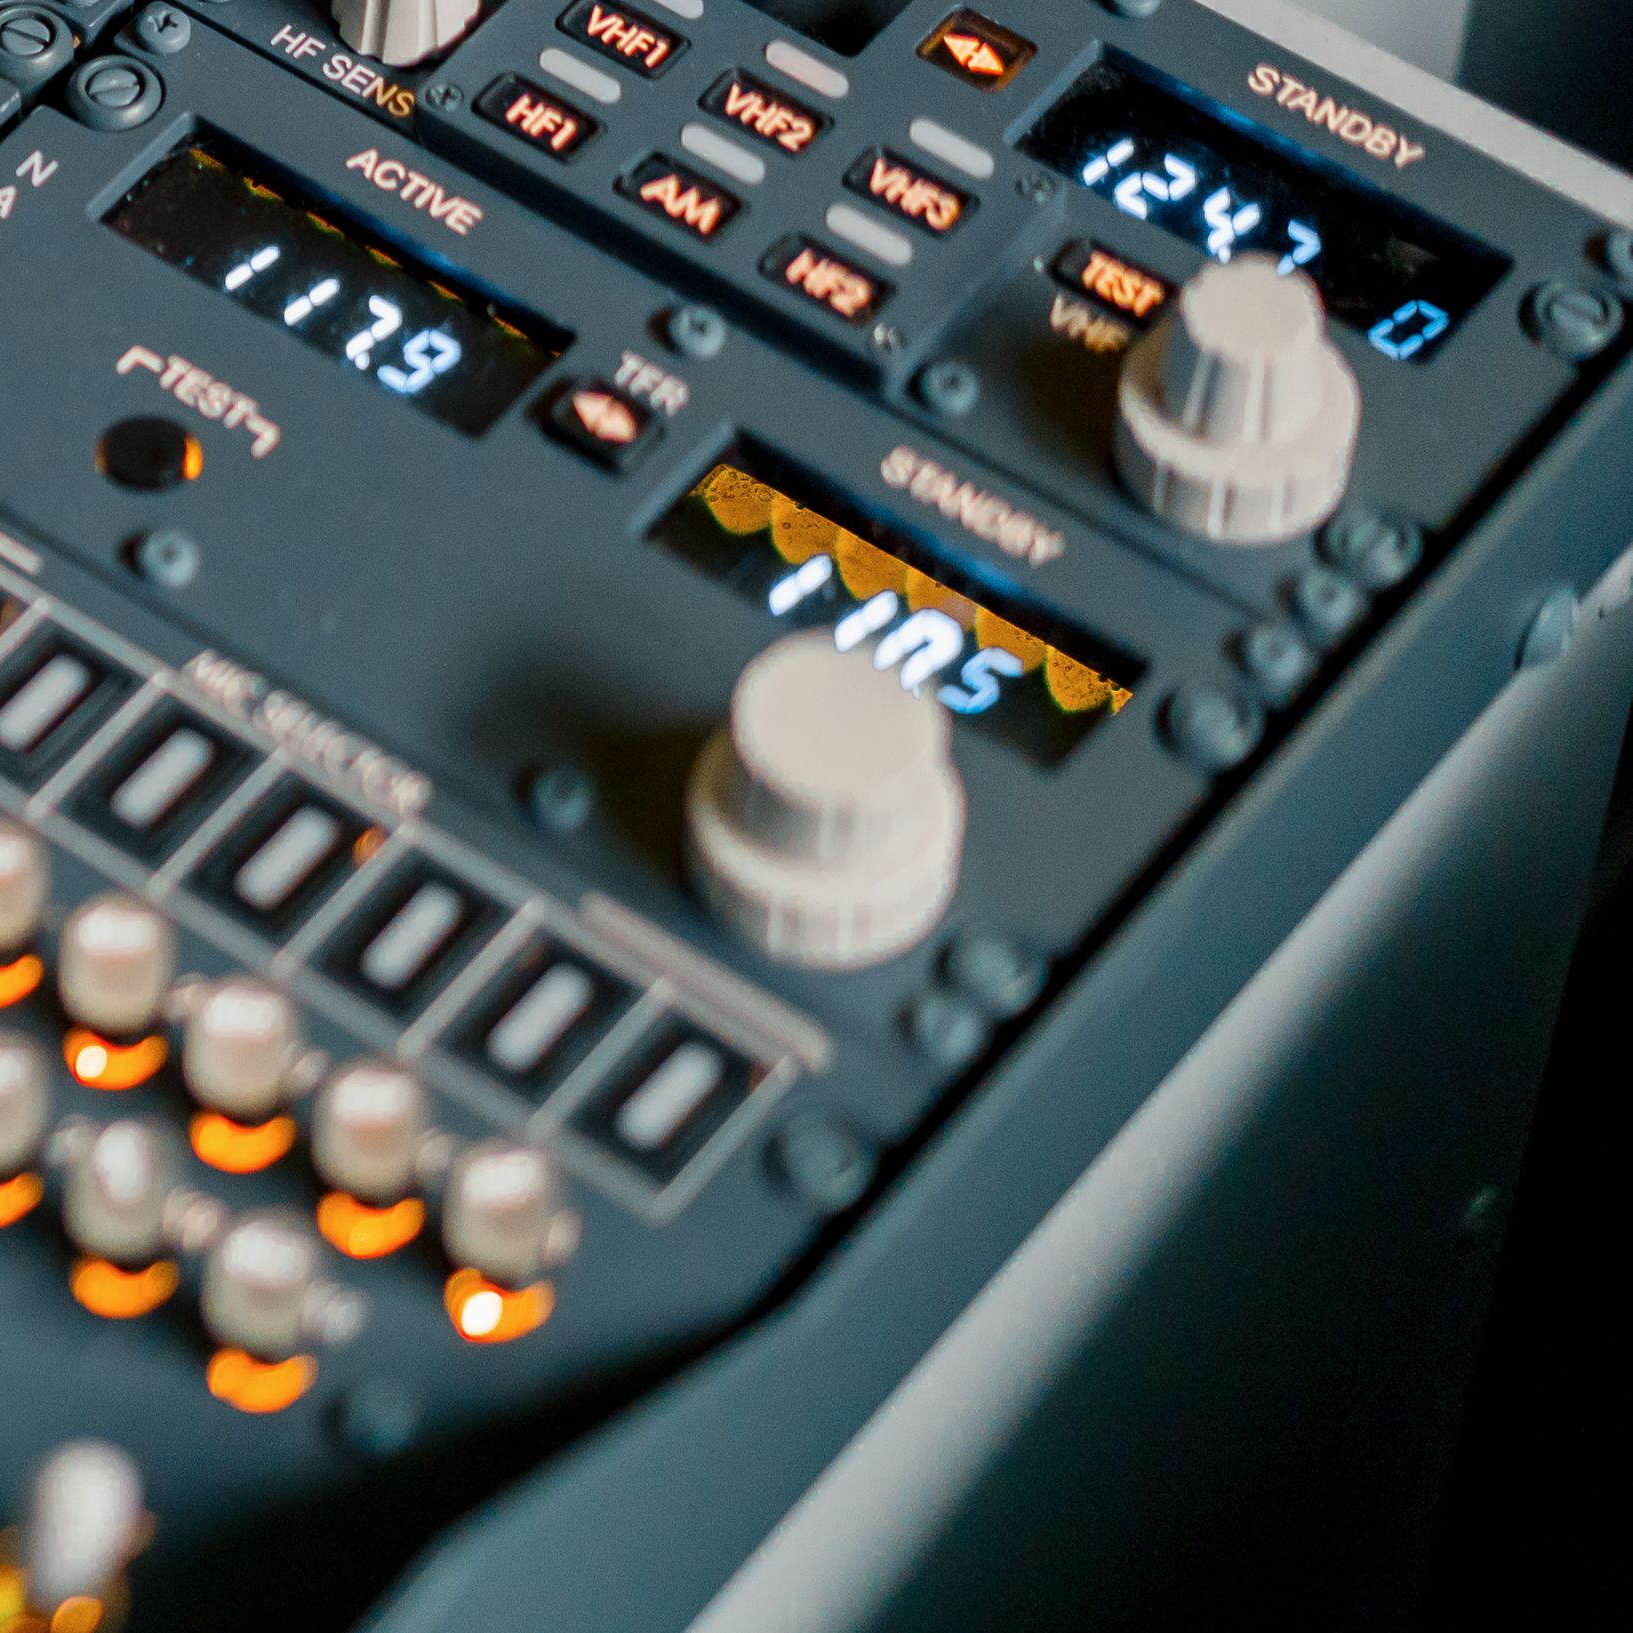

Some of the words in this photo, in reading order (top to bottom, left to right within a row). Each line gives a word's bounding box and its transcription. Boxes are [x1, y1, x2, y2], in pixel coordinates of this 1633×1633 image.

[587, 4, 672, 69] VHF1
[271, 24, 324, 63] HF
[322, 55, 417, 119] SENS
[504, 93, 577, 151] HF1
[724, 82, 816, 153] VHF2
[1246, 63, 1425, 171] STANDBY
[346, 148, 484, 237] ACTIVE
[639, 172, 722, 237] AM
[870, 156, 961, 233] VHF3
[1081, 250, 1166, 317] TEST
[1367, 298, 1451, 362] 0
